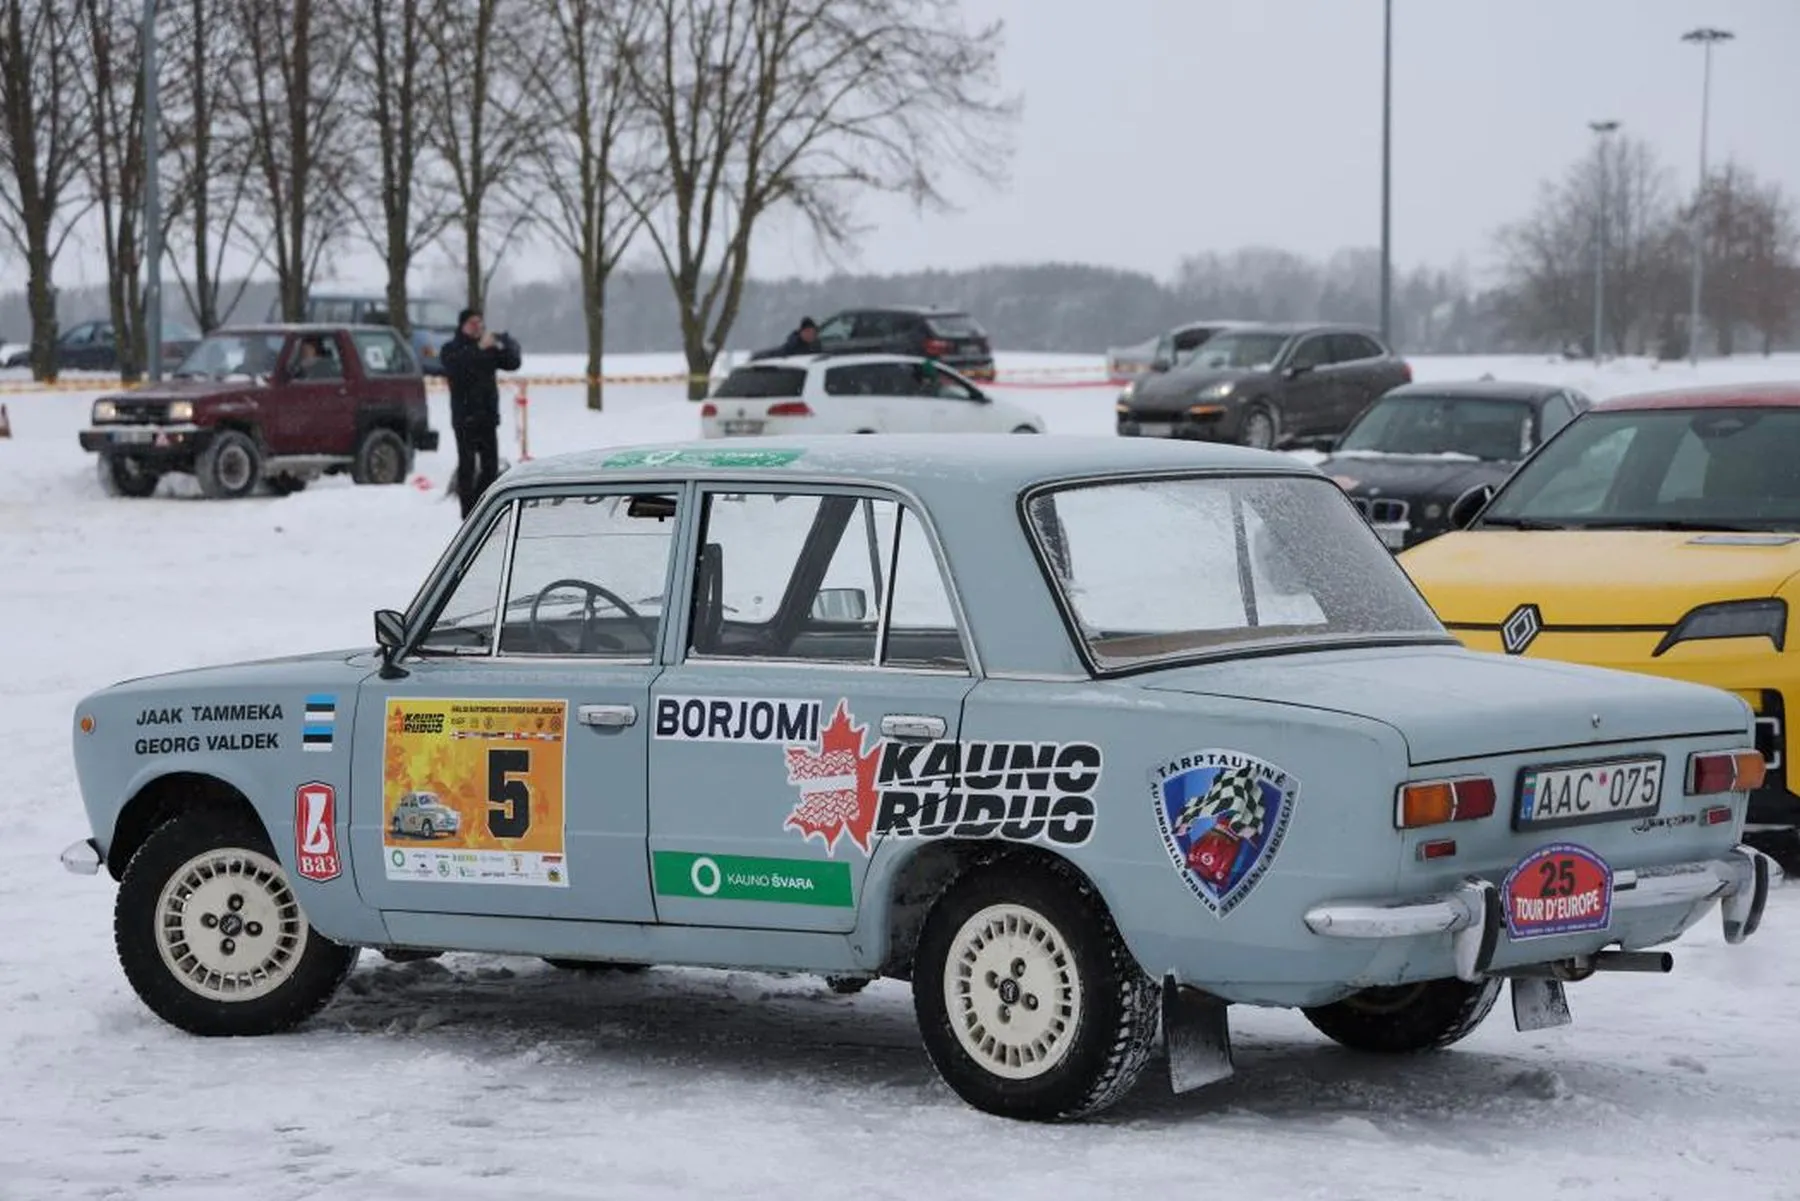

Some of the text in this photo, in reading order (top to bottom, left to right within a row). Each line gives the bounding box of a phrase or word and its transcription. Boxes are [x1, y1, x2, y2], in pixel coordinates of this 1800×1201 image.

[136, 703, 284, 726] JAAK TAMMEKA
[656, 697, 820, 742] BORJOMI
[135, 733, 280, 755] GEORG VALDEK
[878, 741, 1101, 793] KAUNO
[1156, 754, 1288, 786] TARPTAUTINĖ
[487, 749, 531, 839] 5
[1537, 765, 1657, 817] AAC 075
[876, 791, 1096, 844] RUDUO
[727, 873, 815, 890] KAUNO ŠVARA
[1181, 867, 1217, 912] SPORTO
[1538, 860, 1577, 897] 25
[1516, 889, 1600, 921] TOUR D'EUROPE
